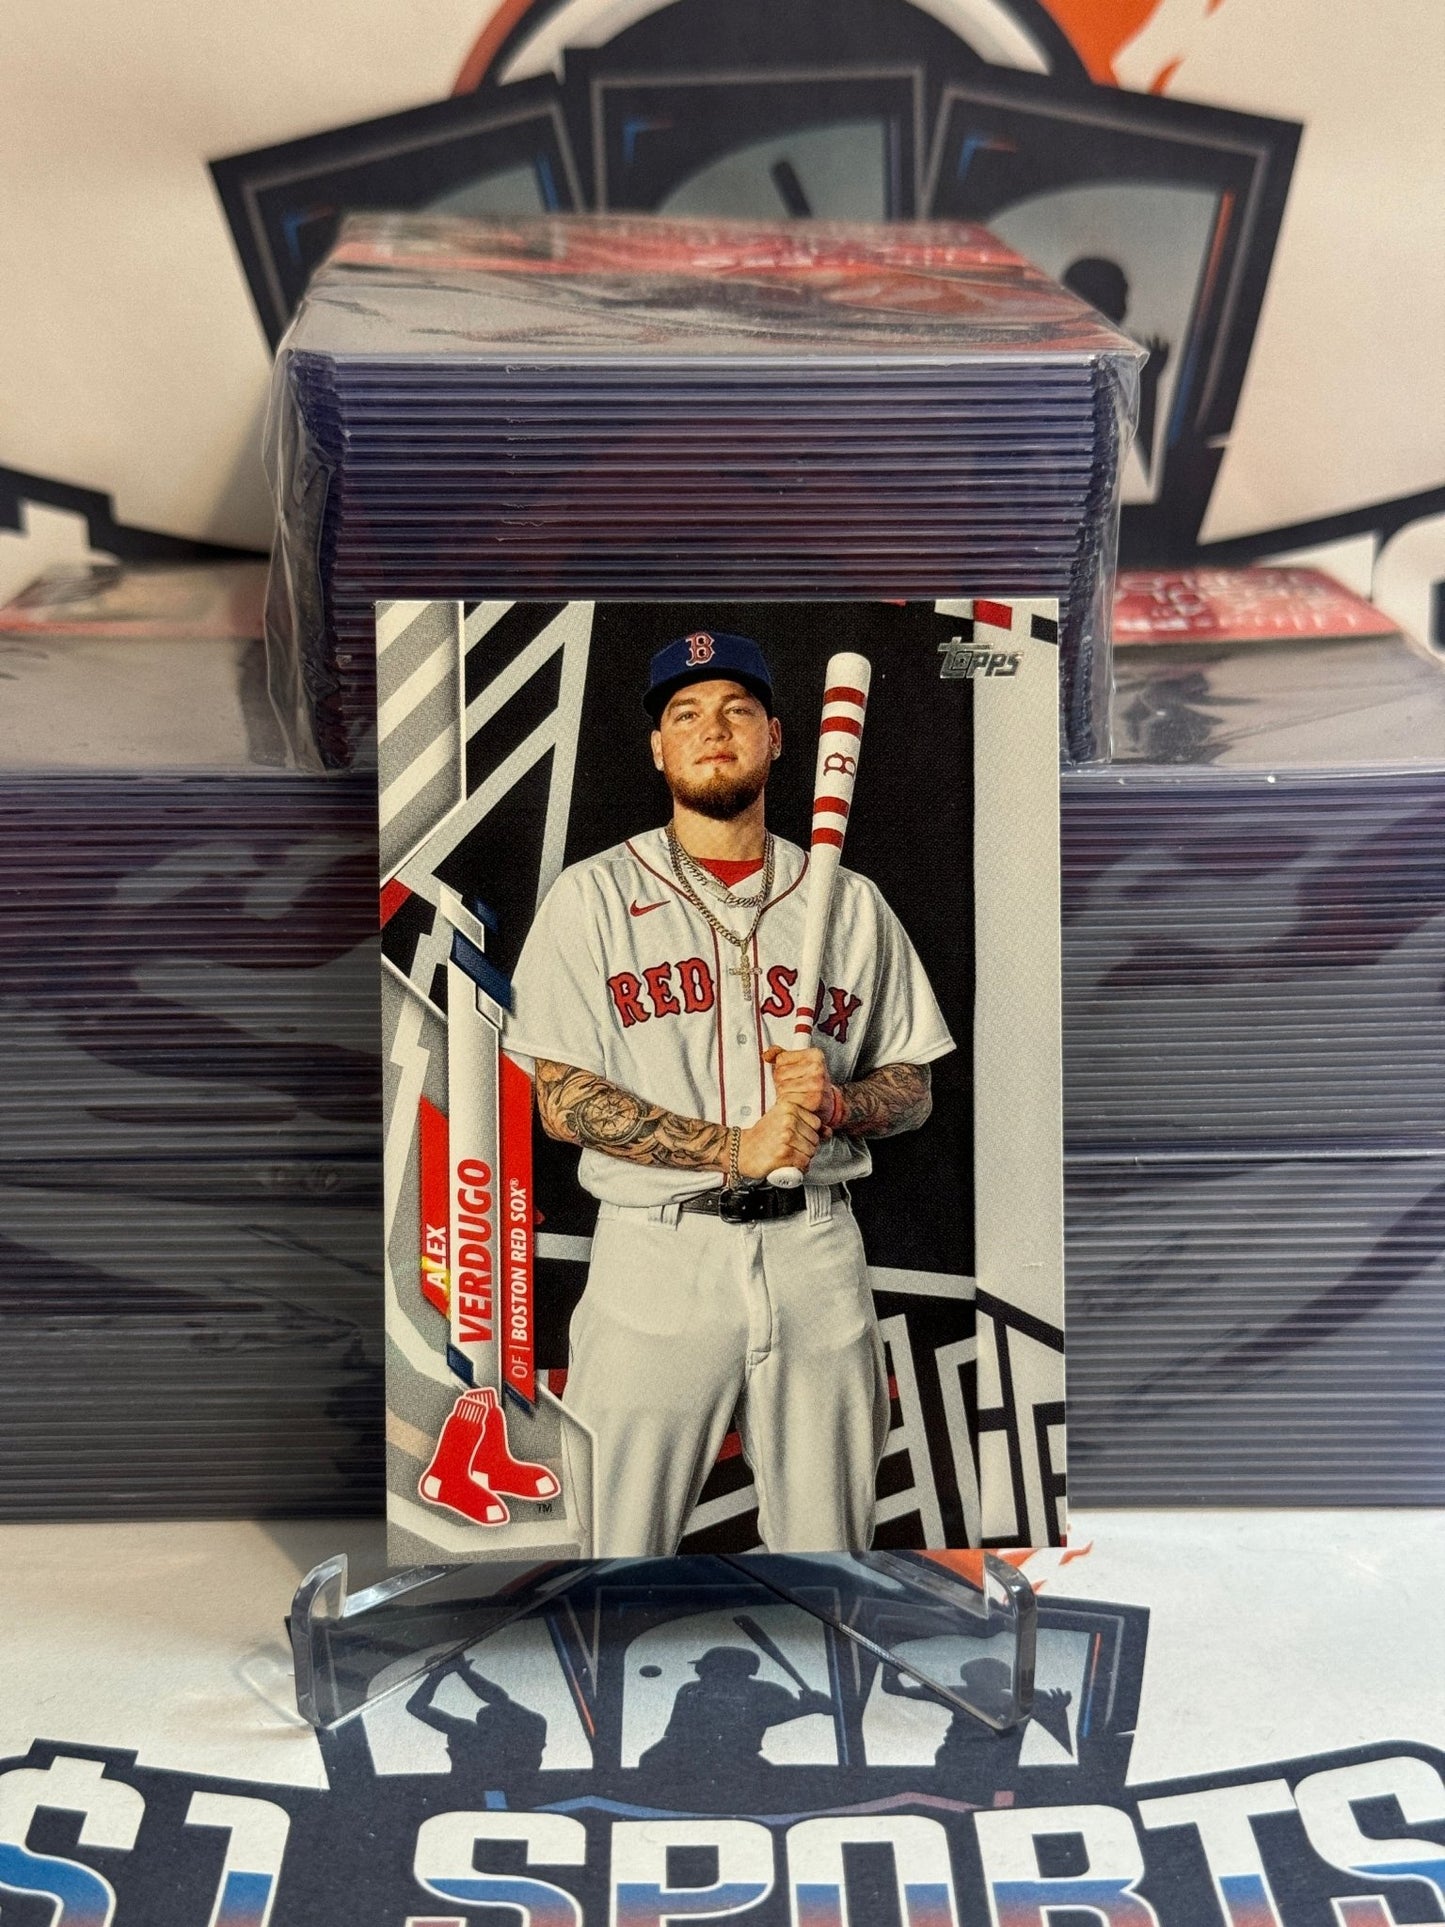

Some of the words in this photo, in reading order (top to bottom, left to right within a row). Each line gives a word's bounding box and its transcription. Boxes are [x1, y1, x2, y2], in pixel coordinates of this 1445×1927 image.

[685, 632, 715, 666] B
[606, 957, 715, 1028] RED
[760, 965, 863, 1044] SX
[427, 1223, 448, 1291] ALEX
[457, 1158, 493, 1343] VERDUGO
[510, 1227, 527, 1263] RED
[511, 1266, 528, 1342] BOSTON
[512, 1354, 528, 1379] OF
[414, 1756, 1445, 1927] SPORTS
